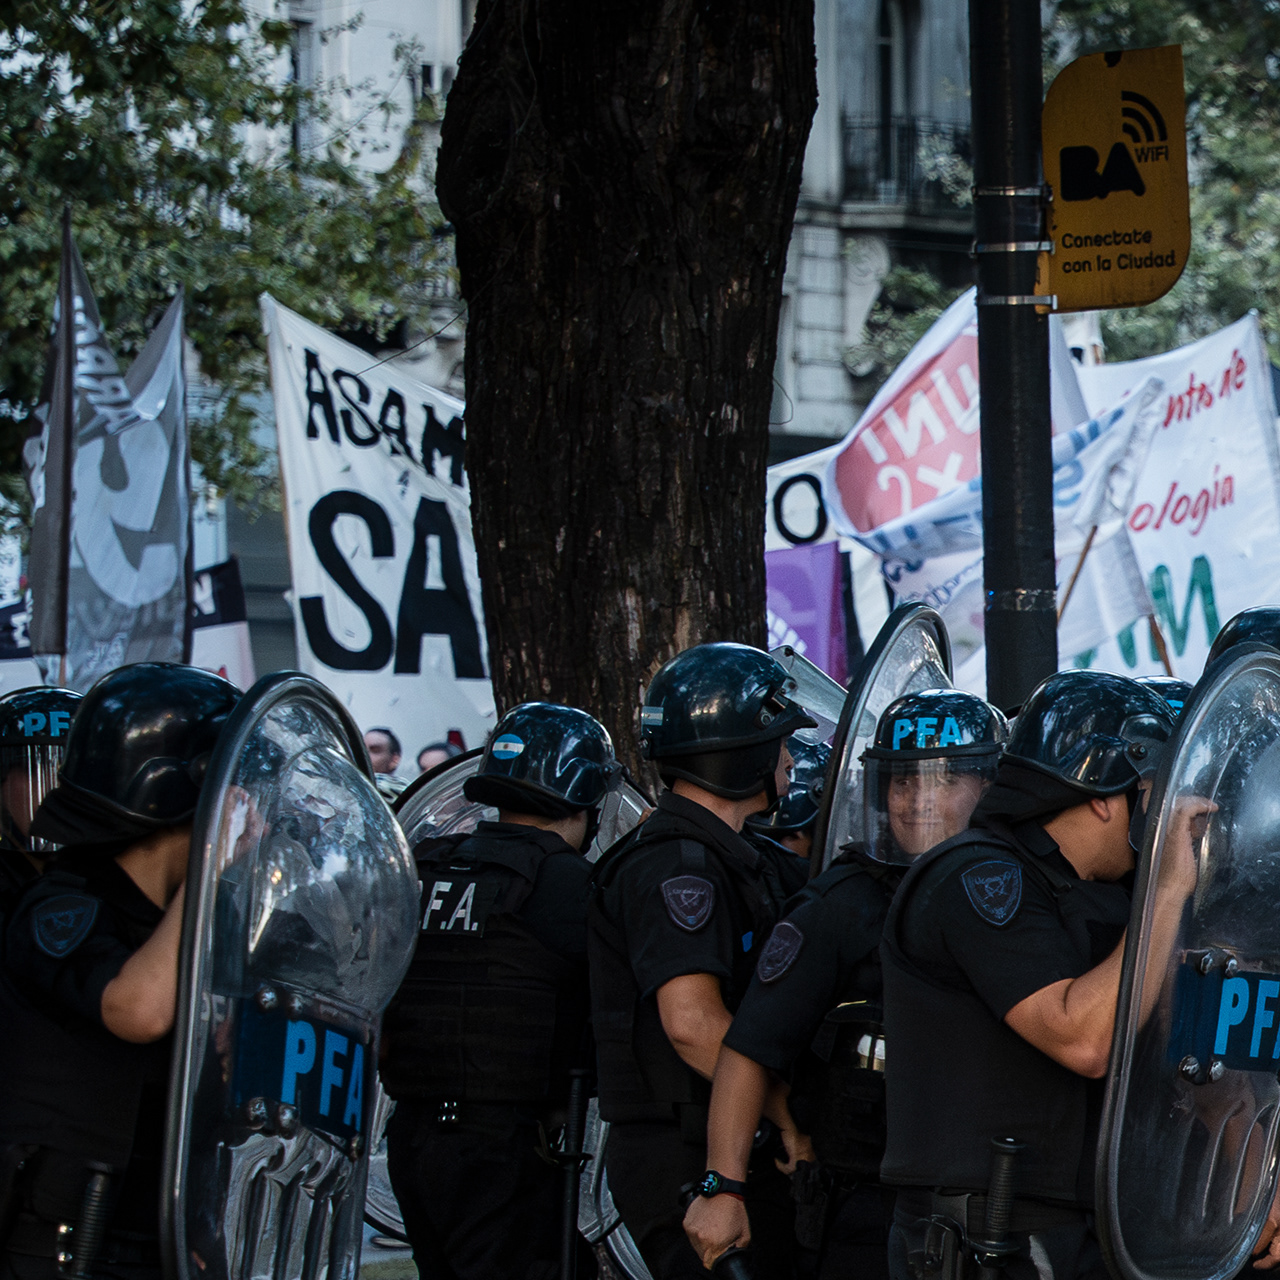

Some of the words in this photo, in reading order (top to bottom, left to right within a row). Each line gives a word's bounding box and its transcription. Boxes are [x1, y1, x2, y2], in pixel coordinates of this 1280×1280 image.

[1060, 142, 1146, 201] BA
[1061, 228, 1153, 249] Conectate
[1062, 260, 1092, 273] con
[1096, 255, 1112, 271] la
[1117, 249, 1176, 270] Ciudad
[304, 347, 469, 488] ASAM
[300, 490, 489, 678] SA
[24, 711, 71, 737] PF
[892, 717, 963, 751] PFA
[281, 1020, 364, 1132] PFA
